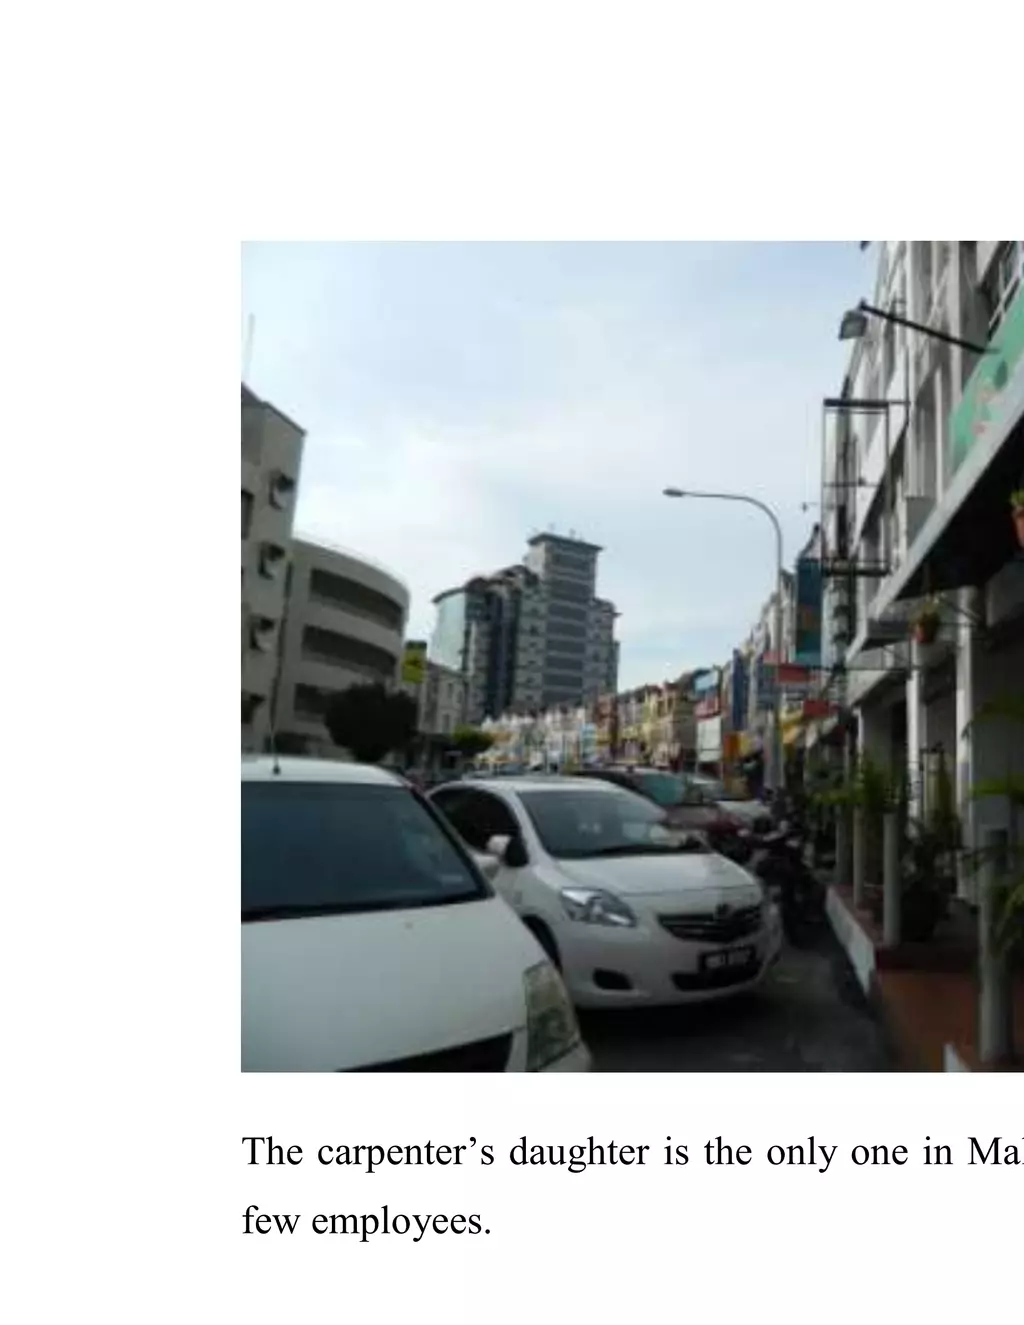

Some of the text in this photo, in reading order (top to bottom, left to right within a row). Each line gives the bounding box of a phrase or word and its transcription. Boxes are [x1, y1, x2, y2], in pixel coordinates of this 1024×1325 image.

[242, 1136, 302, 1165] The
[318, 1137, 494, 1173] carpenter’s
[510, 1136, 650, 1173] daughter
[664, 1136, 688, 1165] is
[704, 1136, 752, 1165] the
[767, 1136, 838, 1173] only
[852, 1145, 908, 1165] one
[924, 1136, 953, 1164] in
[242, 1205, 490, 1242] few employees.
